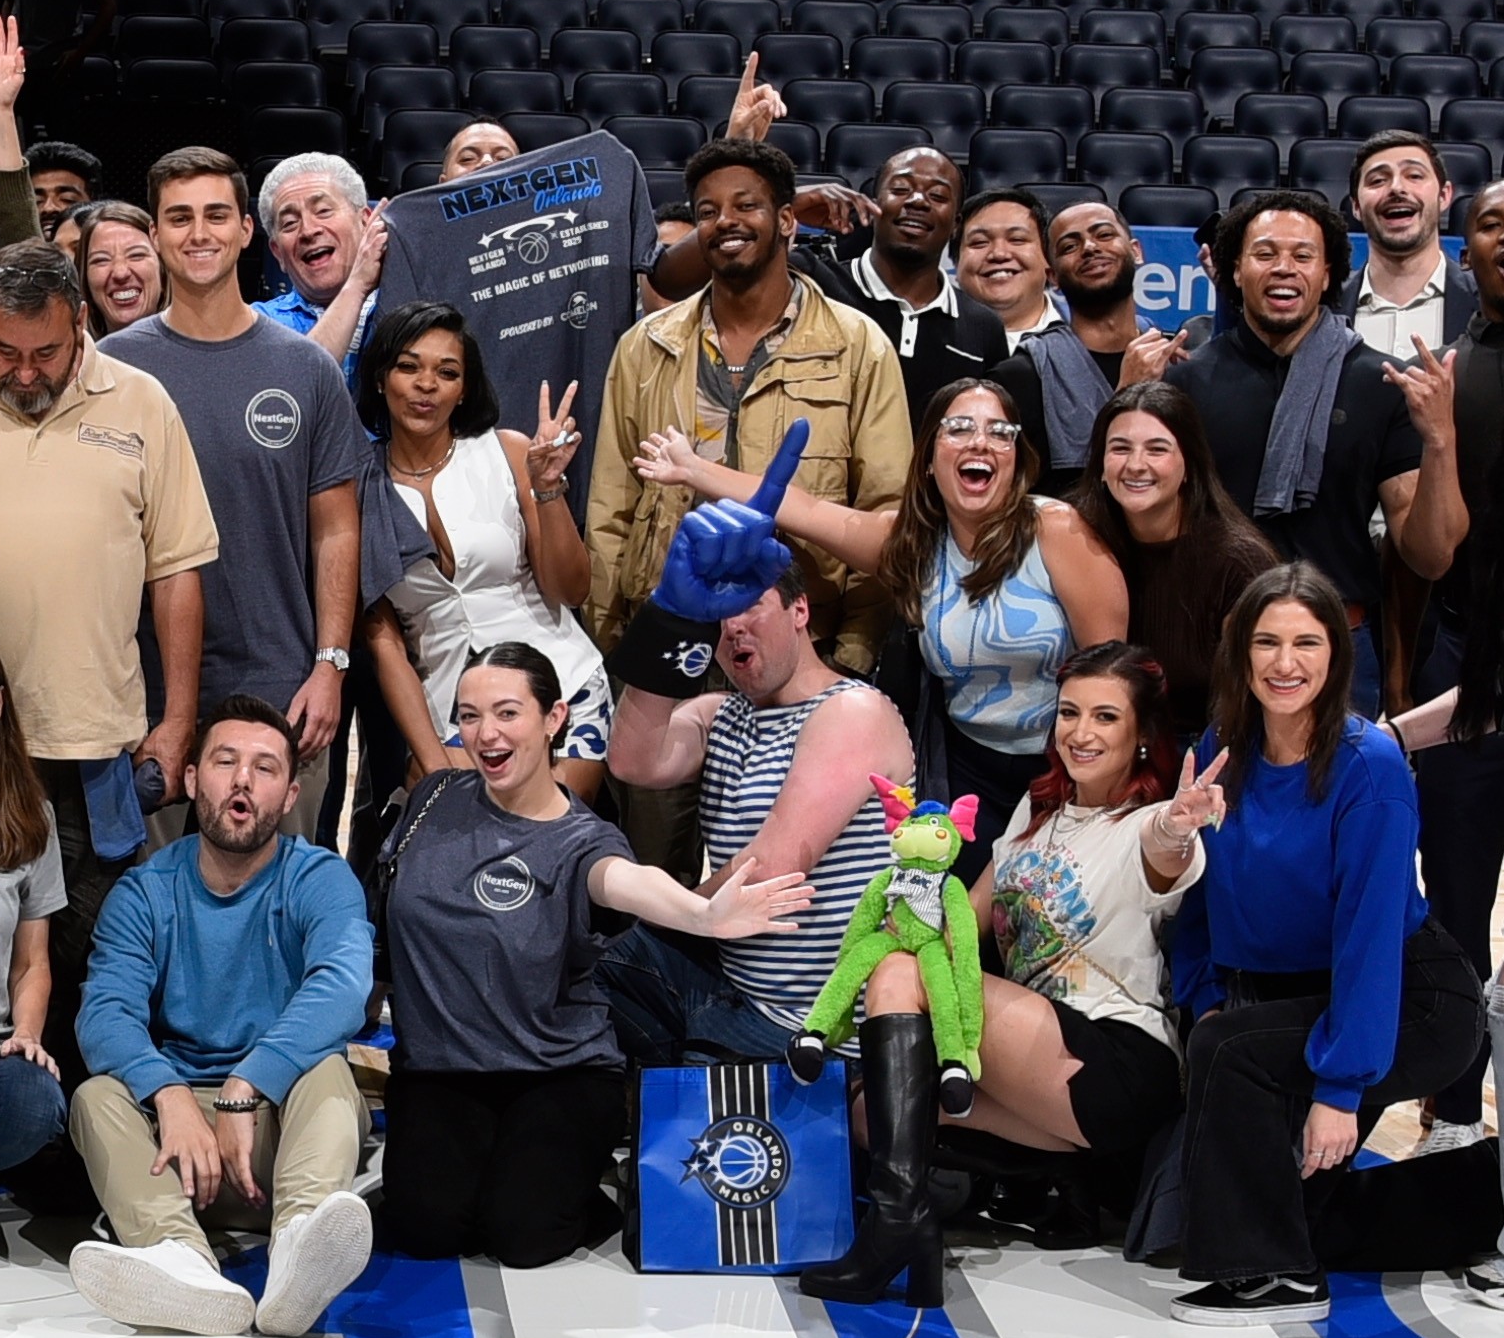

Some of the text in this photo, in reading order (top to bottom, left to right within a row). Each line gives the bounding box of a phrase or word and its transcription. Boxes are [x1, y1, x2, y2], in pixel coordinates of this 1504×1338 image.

[439, 157, 600, 222] NEXTGEN
[534, 181, 602, 213] Orlando
[471, 257, 507, 275] ORLANDO
[471, 254, 609, 302] THE MAGIC OF NETWORKING
[254, 413, 294, 424] NextGen
[483, 873, 526, 891] NextGen
[733, 1122, 782, 1179] ORLANDO
[719, 1184, 770, 1203] MAGIC
